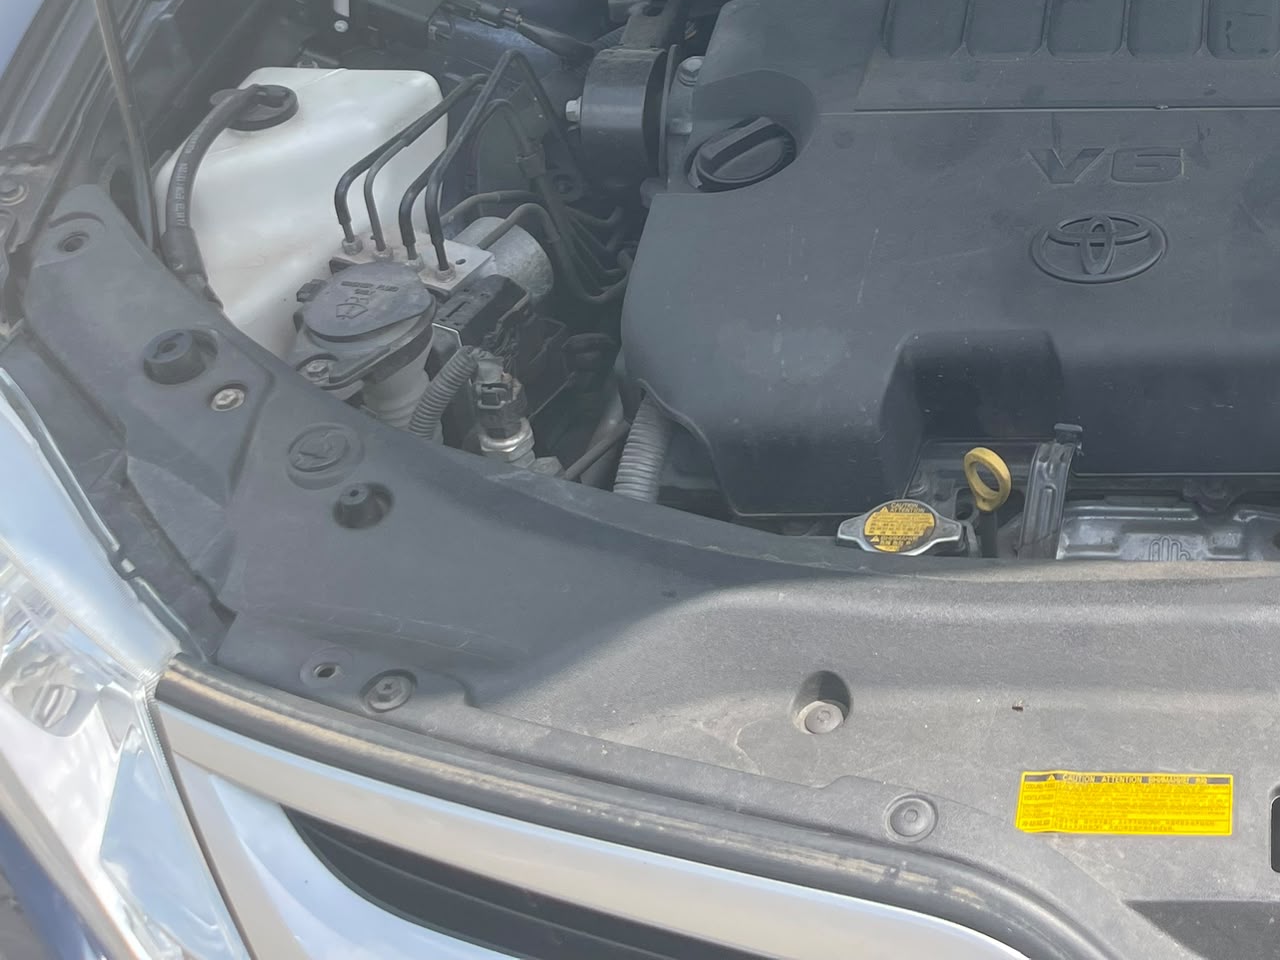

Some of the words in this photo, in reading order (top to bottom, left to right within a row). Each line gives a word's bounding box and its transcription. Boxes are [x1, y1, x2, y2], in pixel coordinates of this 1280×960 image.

[1026, 147, 1184, 185] V6
[1062, 774, 1096, 783] CAUTION
[1101, 775, 1143, 784] ATTENTION
